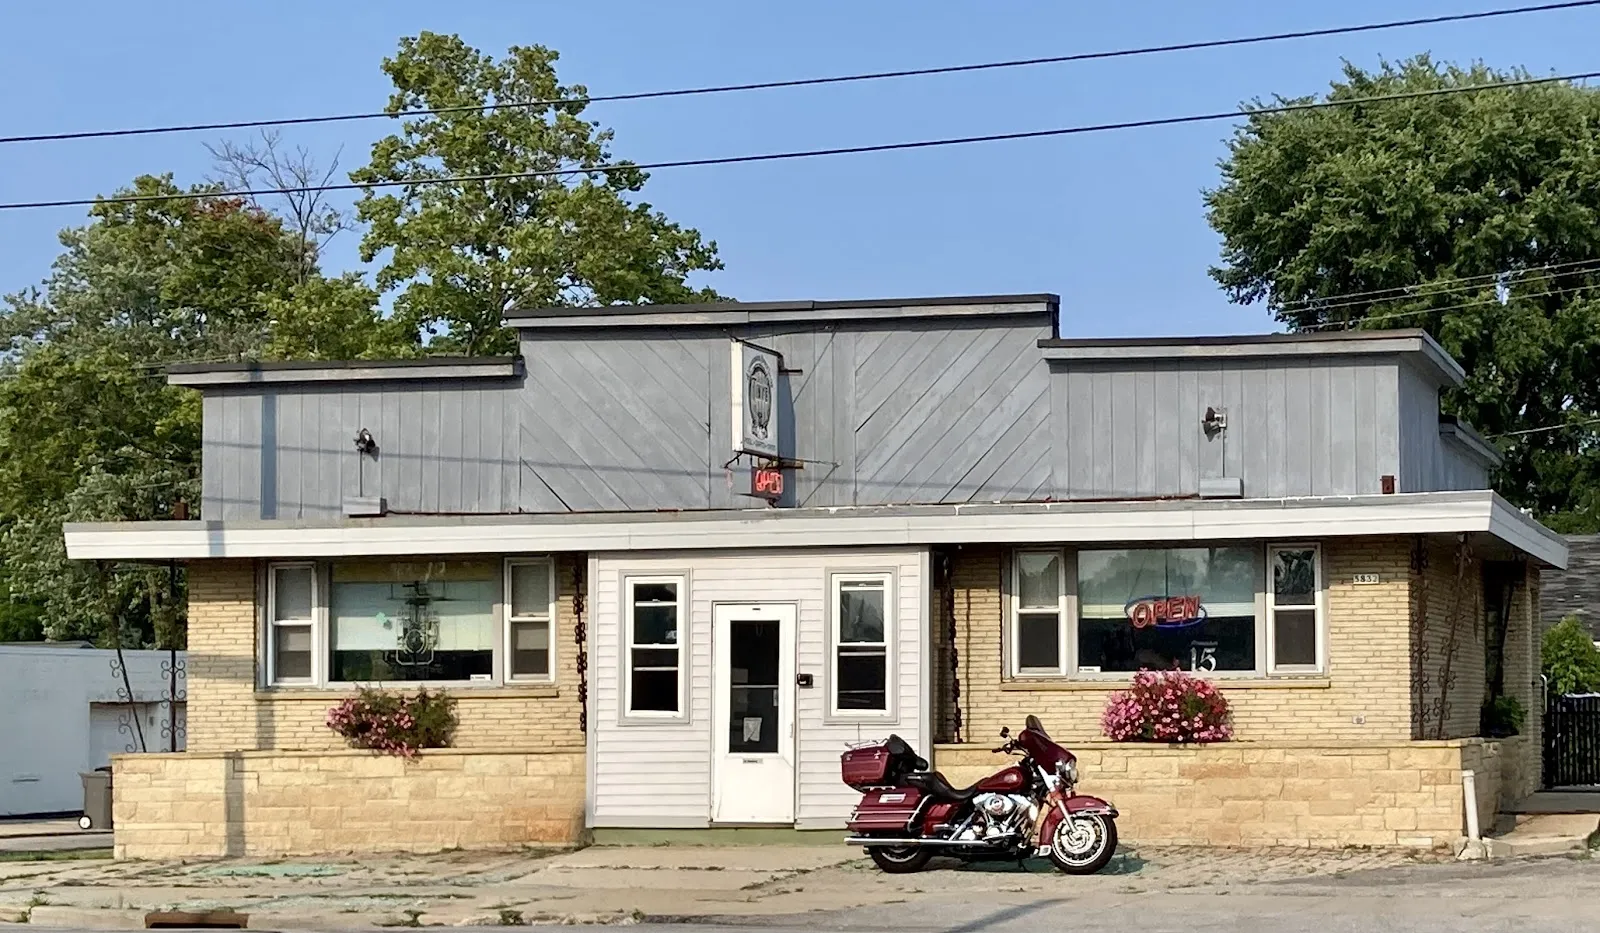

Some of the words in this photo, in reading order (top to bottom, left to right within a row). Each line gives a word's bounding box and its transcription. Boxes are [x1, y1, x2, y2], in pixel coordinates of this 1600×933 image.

[1354, 574, 1378, 583] 5832
[1132, 595, 1200, 629] OPEN
[1190, 646, 1217, 672] 15
